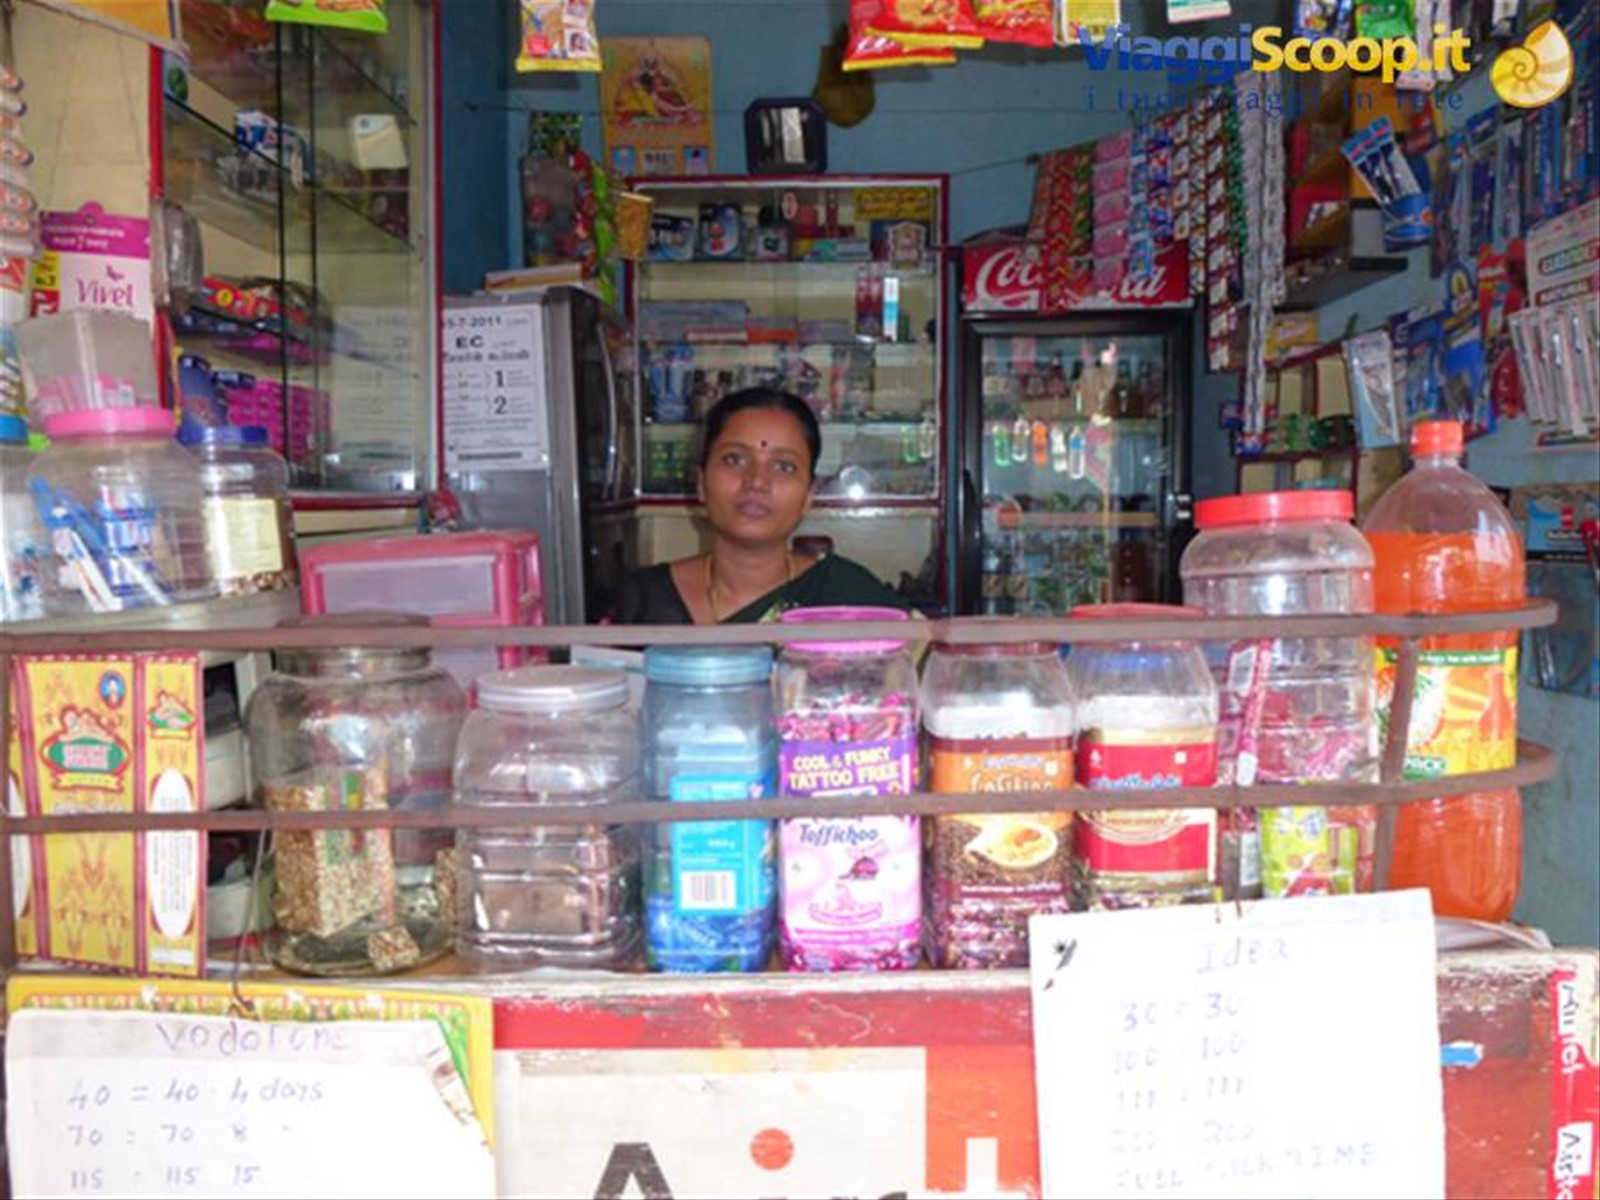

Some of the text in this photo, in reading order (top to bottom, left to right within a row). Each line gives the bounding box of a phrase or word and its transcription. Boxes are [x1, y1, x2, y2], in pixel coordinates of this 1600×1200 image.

[494, 395, 508, 415] 2
[793, 755, 829, 772] COOL
[843, 746, 891, 767] FUNKY
[788, 763, 899, 790] TATTOO FREE
[166, 1078, 199, 1102] 40
[230, 1076, 249, 1104] 4
[259, 1076, 324, 1102] days
[160, 1123, 194, 1142] 70
